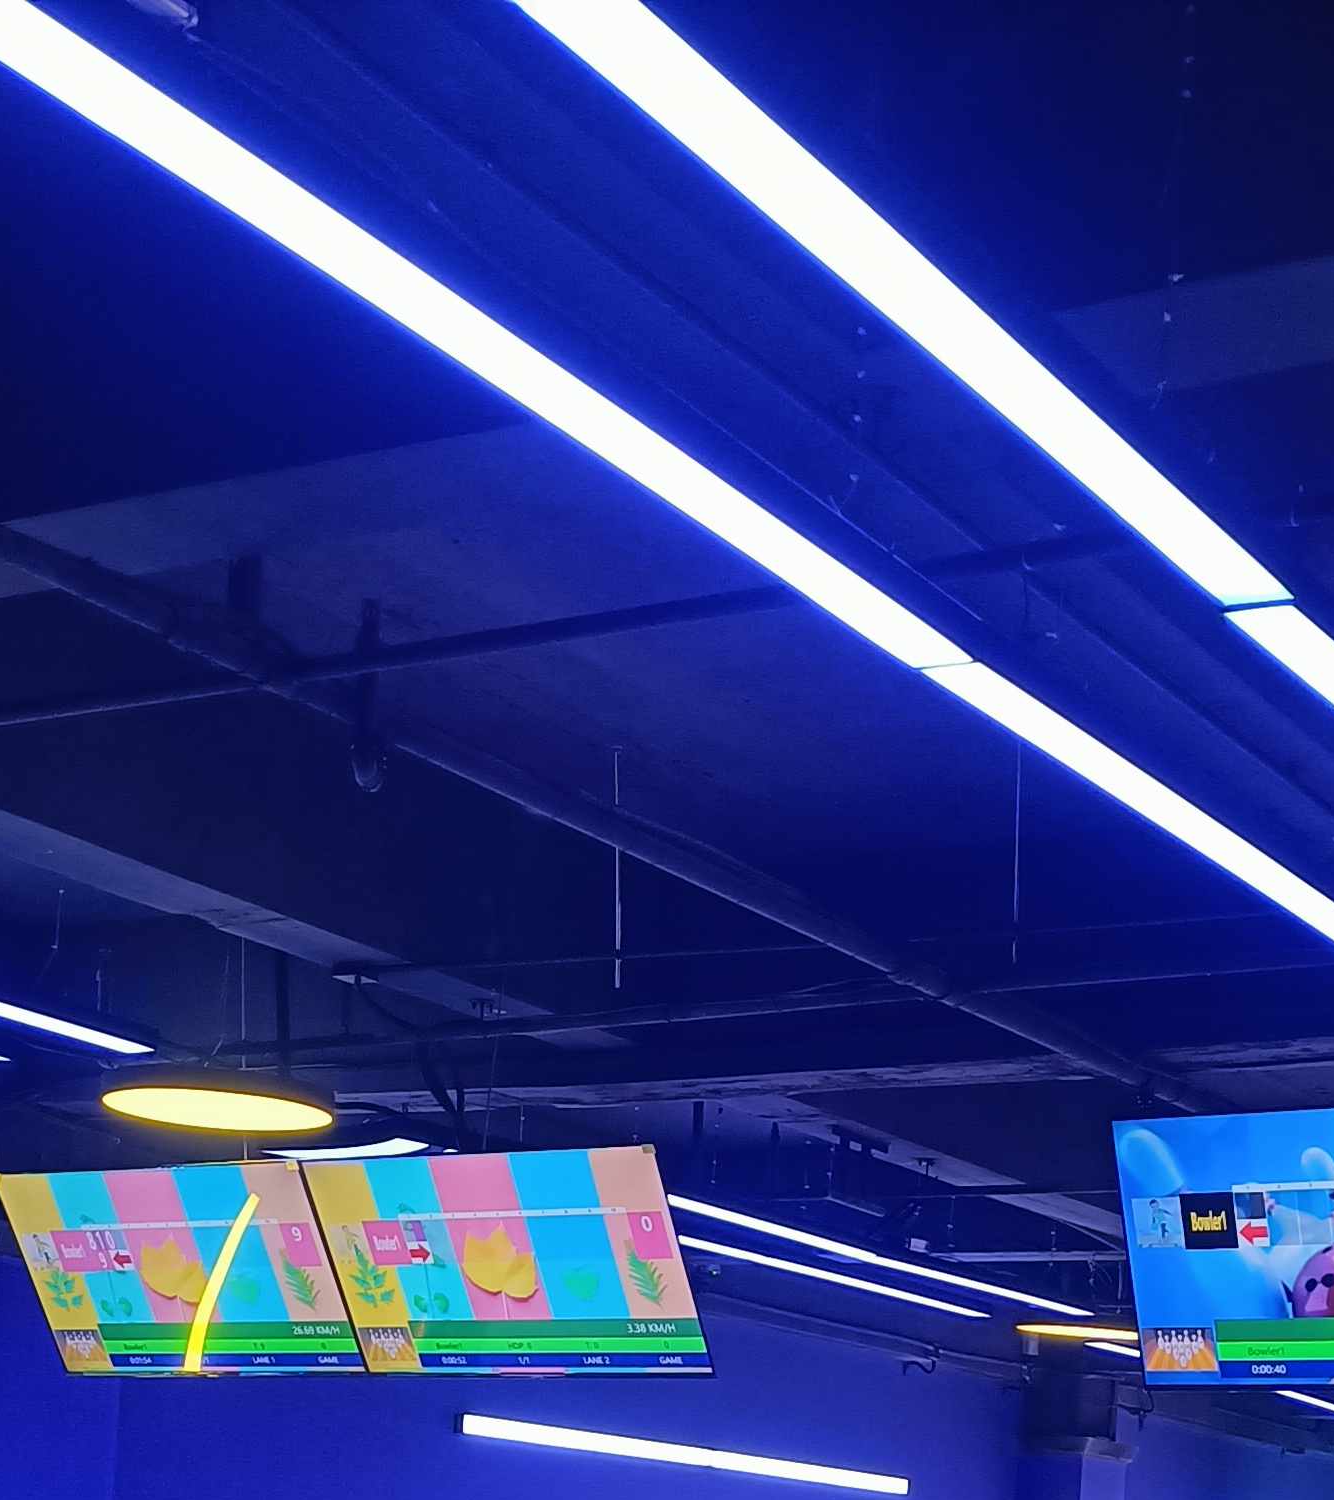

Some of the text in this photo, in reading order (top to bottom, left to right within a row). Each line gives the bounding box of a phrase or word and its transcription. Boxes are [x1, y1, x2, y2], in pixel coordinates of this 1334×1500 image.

[640, 1215, 653, 1232] 0
[1190, 1210, 1228, 1232] Bowler1
[291, 1226, 302, 1242] 9
[98, 1252, 108, 1269] 9
[626, 1323, 676, 1334] 3.38 KM/H
[583, 1356, 603, 1365] LANE
[659, 1356, 684, 1365] GAME
[1251, 1364, 1287, 1375] 0:00:40
